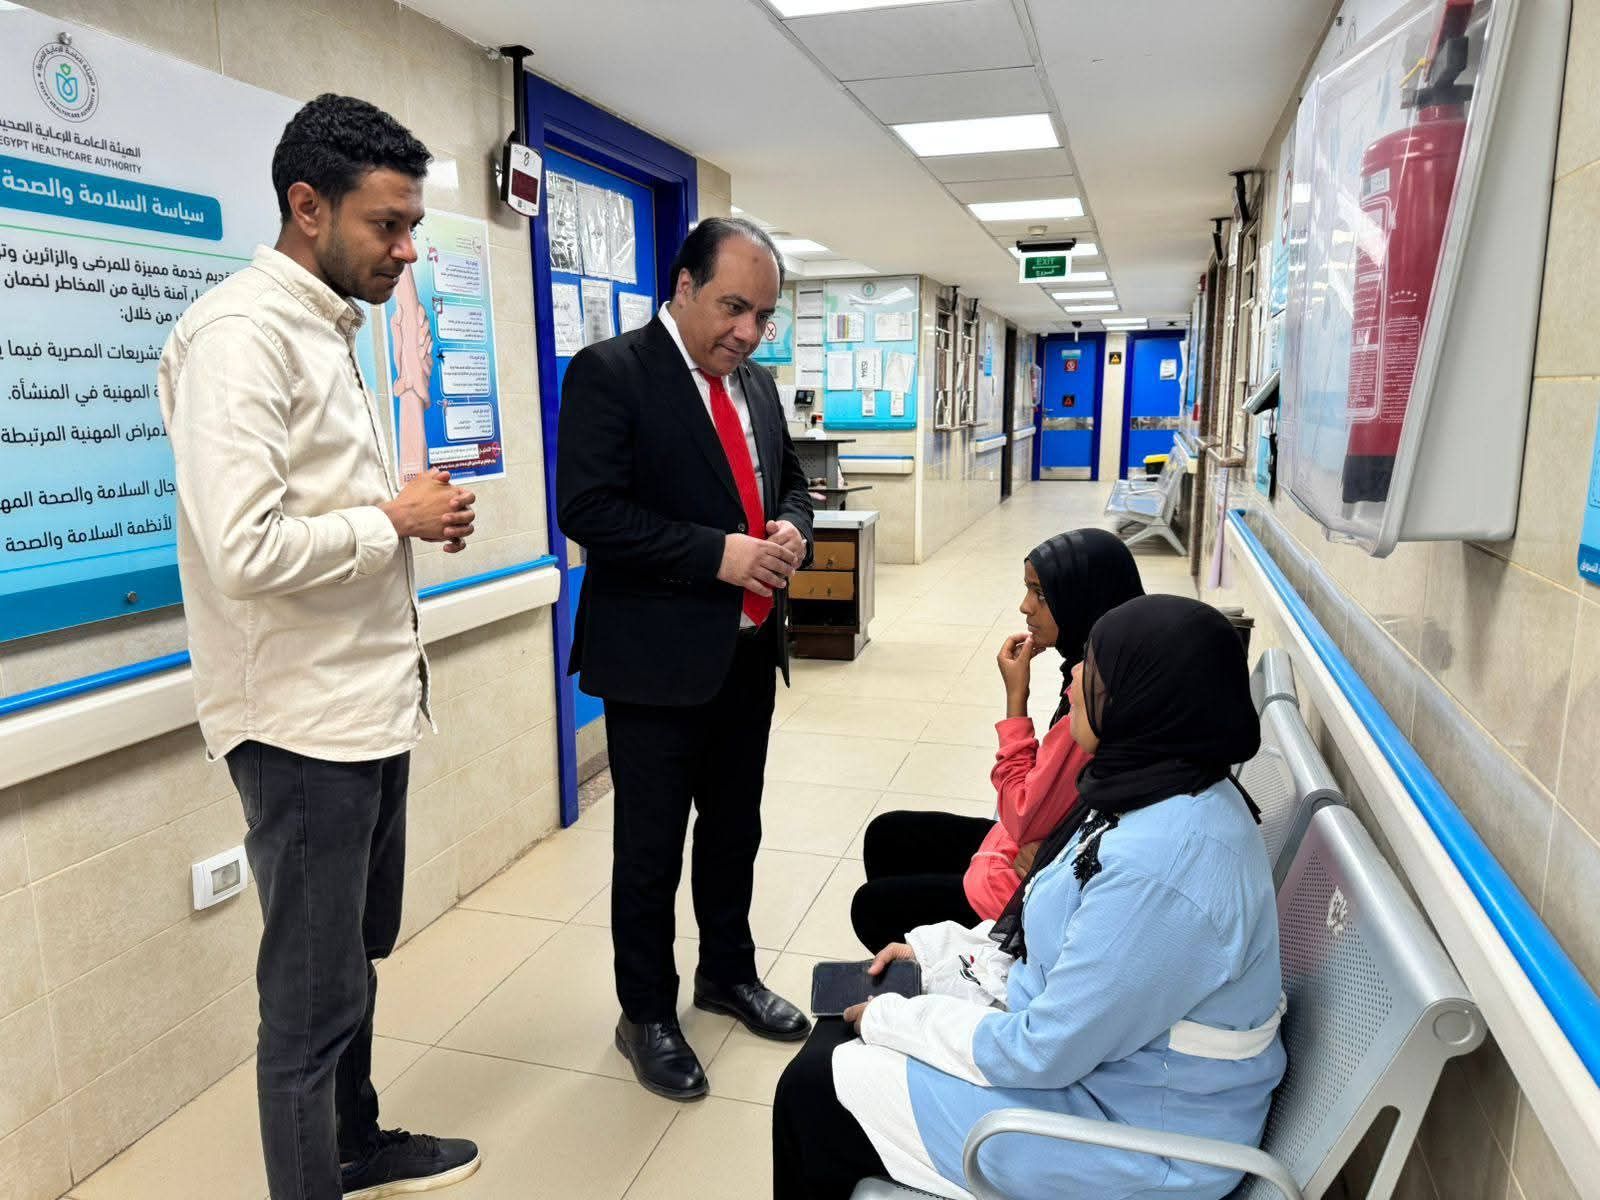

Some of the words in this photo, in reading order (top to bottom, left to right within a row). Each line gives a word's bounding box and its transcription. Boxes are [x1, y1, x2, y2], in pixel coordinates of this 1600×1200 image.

[0, 118, 33, 134] الصحي
[35, 123, 72, 143] للرعاية
[74, 132, 108, 150] العامة
[109, 141, 142, 159] الهيئة
[31, 142, 93, 164] HEALTHCARE
[94, 156, 142, 174] AUTHORITY
[2, 168, 74, 206] والصحة
[79, 183, 147, 214] السلامة
[151, 197, 204, 225] سياسة
[22, 245, 78, 270] والزائرين
[82, 256, 130, 272] للمرضى
[1036, 257, 1057, 266] EXIT
[134, 260, 168, 278] مميزة
[172, 263, 202, 281] خدمة
[4, 270, 50, 289] لضمان
[54, 276, 105, 294] المخاطر
[109, 284, 128, 298] من
[131, 282, 161, 301] خالية
[164, 284, 188, 302] آمنة
[155, 311, 173, 325] من
[8, 339, 42, 361] فيما
[47, 341, 102, 362] المصرية
[75, 385, 99, 408] في
[103, 383, 150, 403] المهنية
[1, 424, 66, 447] المرتبطة
[71, 423, 120, 444] المهنية
[38, 486, 93, 507] والصحة
[98, 480, 149, 500] السلامة
[0, 491, 33, 514] المه
[5, 532, 63, 553] والصحة
[68, 522, 123, 545] السلامة
